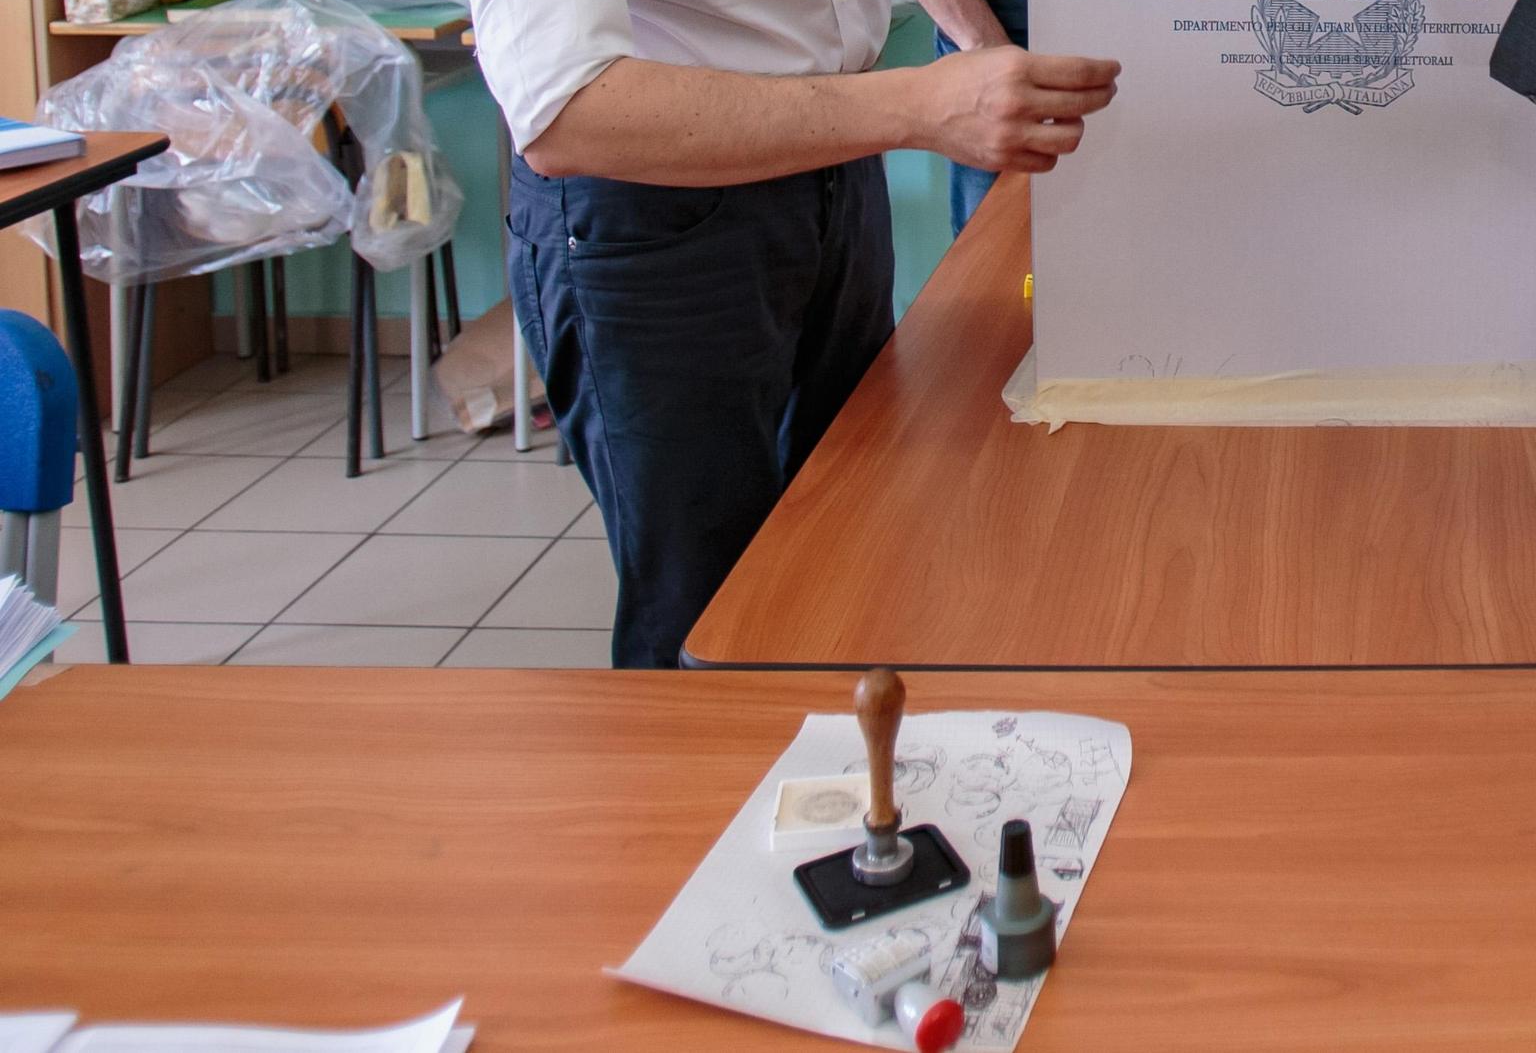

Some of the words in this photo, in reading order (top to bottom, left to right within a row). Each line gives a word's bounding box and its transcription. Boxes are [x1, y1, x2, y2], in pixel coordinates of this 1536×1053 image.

[1173, 20, 1262, 32] DIPARTIMENTO
[1266, 20, 1287, 33] PER
[1289, 21, 1313, 33] GLI
[1316, 21, 1354, 34] AFFARI
[1357, 22, 1407, 34] INTERNI
[1422, 22, 1501, 35] TERRITORIALI
[1220, 53, 1276, 65] DIREZIONE
[1279, 54, 1330, 65] CENTRALE
[1331, 54, 1352, 65] DEI
[1353, 54, 1391, 66] SERVIZI
[1394, 55, 1453, 66] ELETTORALI
[1346, 77, 1411, 104] ITALIANA
